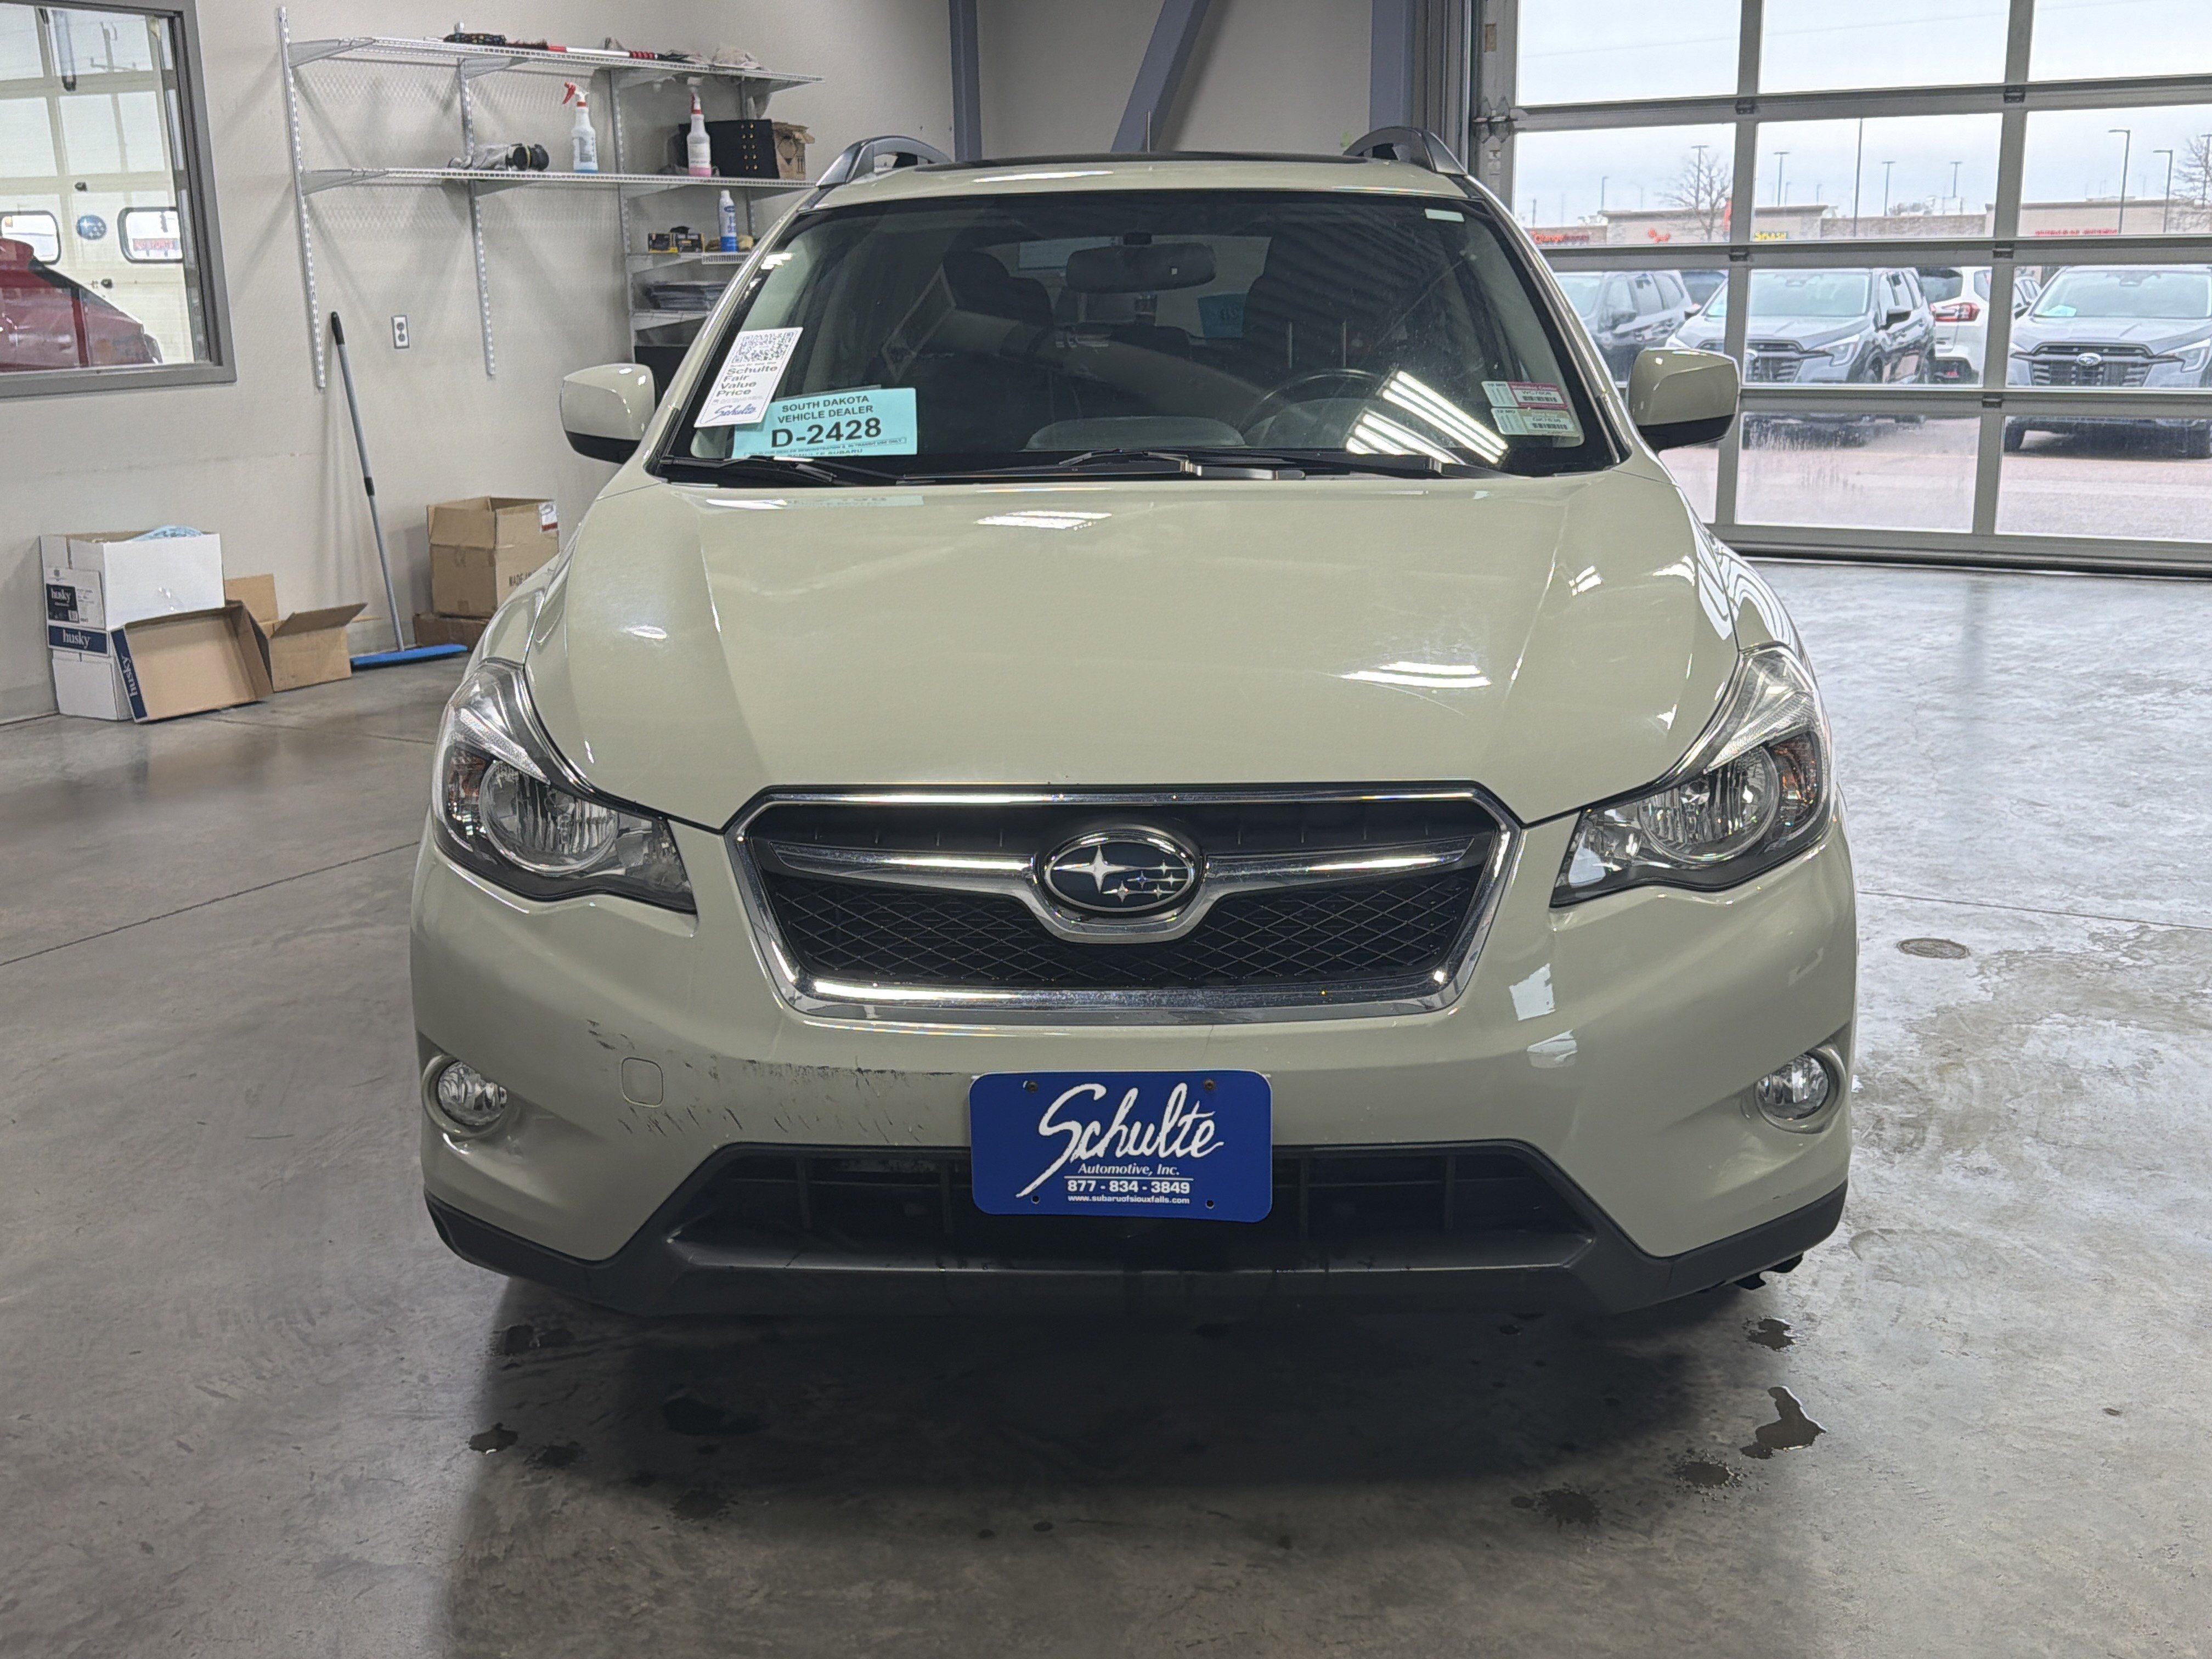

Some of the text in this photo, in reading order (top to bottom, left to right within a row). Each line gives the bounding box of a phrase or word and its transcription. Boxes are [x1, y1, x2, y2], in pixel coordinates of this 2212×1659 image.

[726, 366, 778, 375] Schulte
[782, 396, 869, 413] SOUTH DAKOTA
[777, 405, 873, 424] VEHICLE DEALER
[771, 417, 881, 448] D-2428
[50, 588, 71, 603] husky
[63, 629, 92, 649] husky
[121, 653, 138, 696] husky
[1016, 1082, 1224, 1198] Schulte
[1078, 1163, 1180, 1176] Automotive, Inc.
[1068, 1180, 1096, 1192] 877
[1109, 1181, 1138, 1193] 834
[1151, 1181, 1190, 1194] 3849
[1068, 1194, 1190, 1204] www.subaruofsiouxfalls.com
